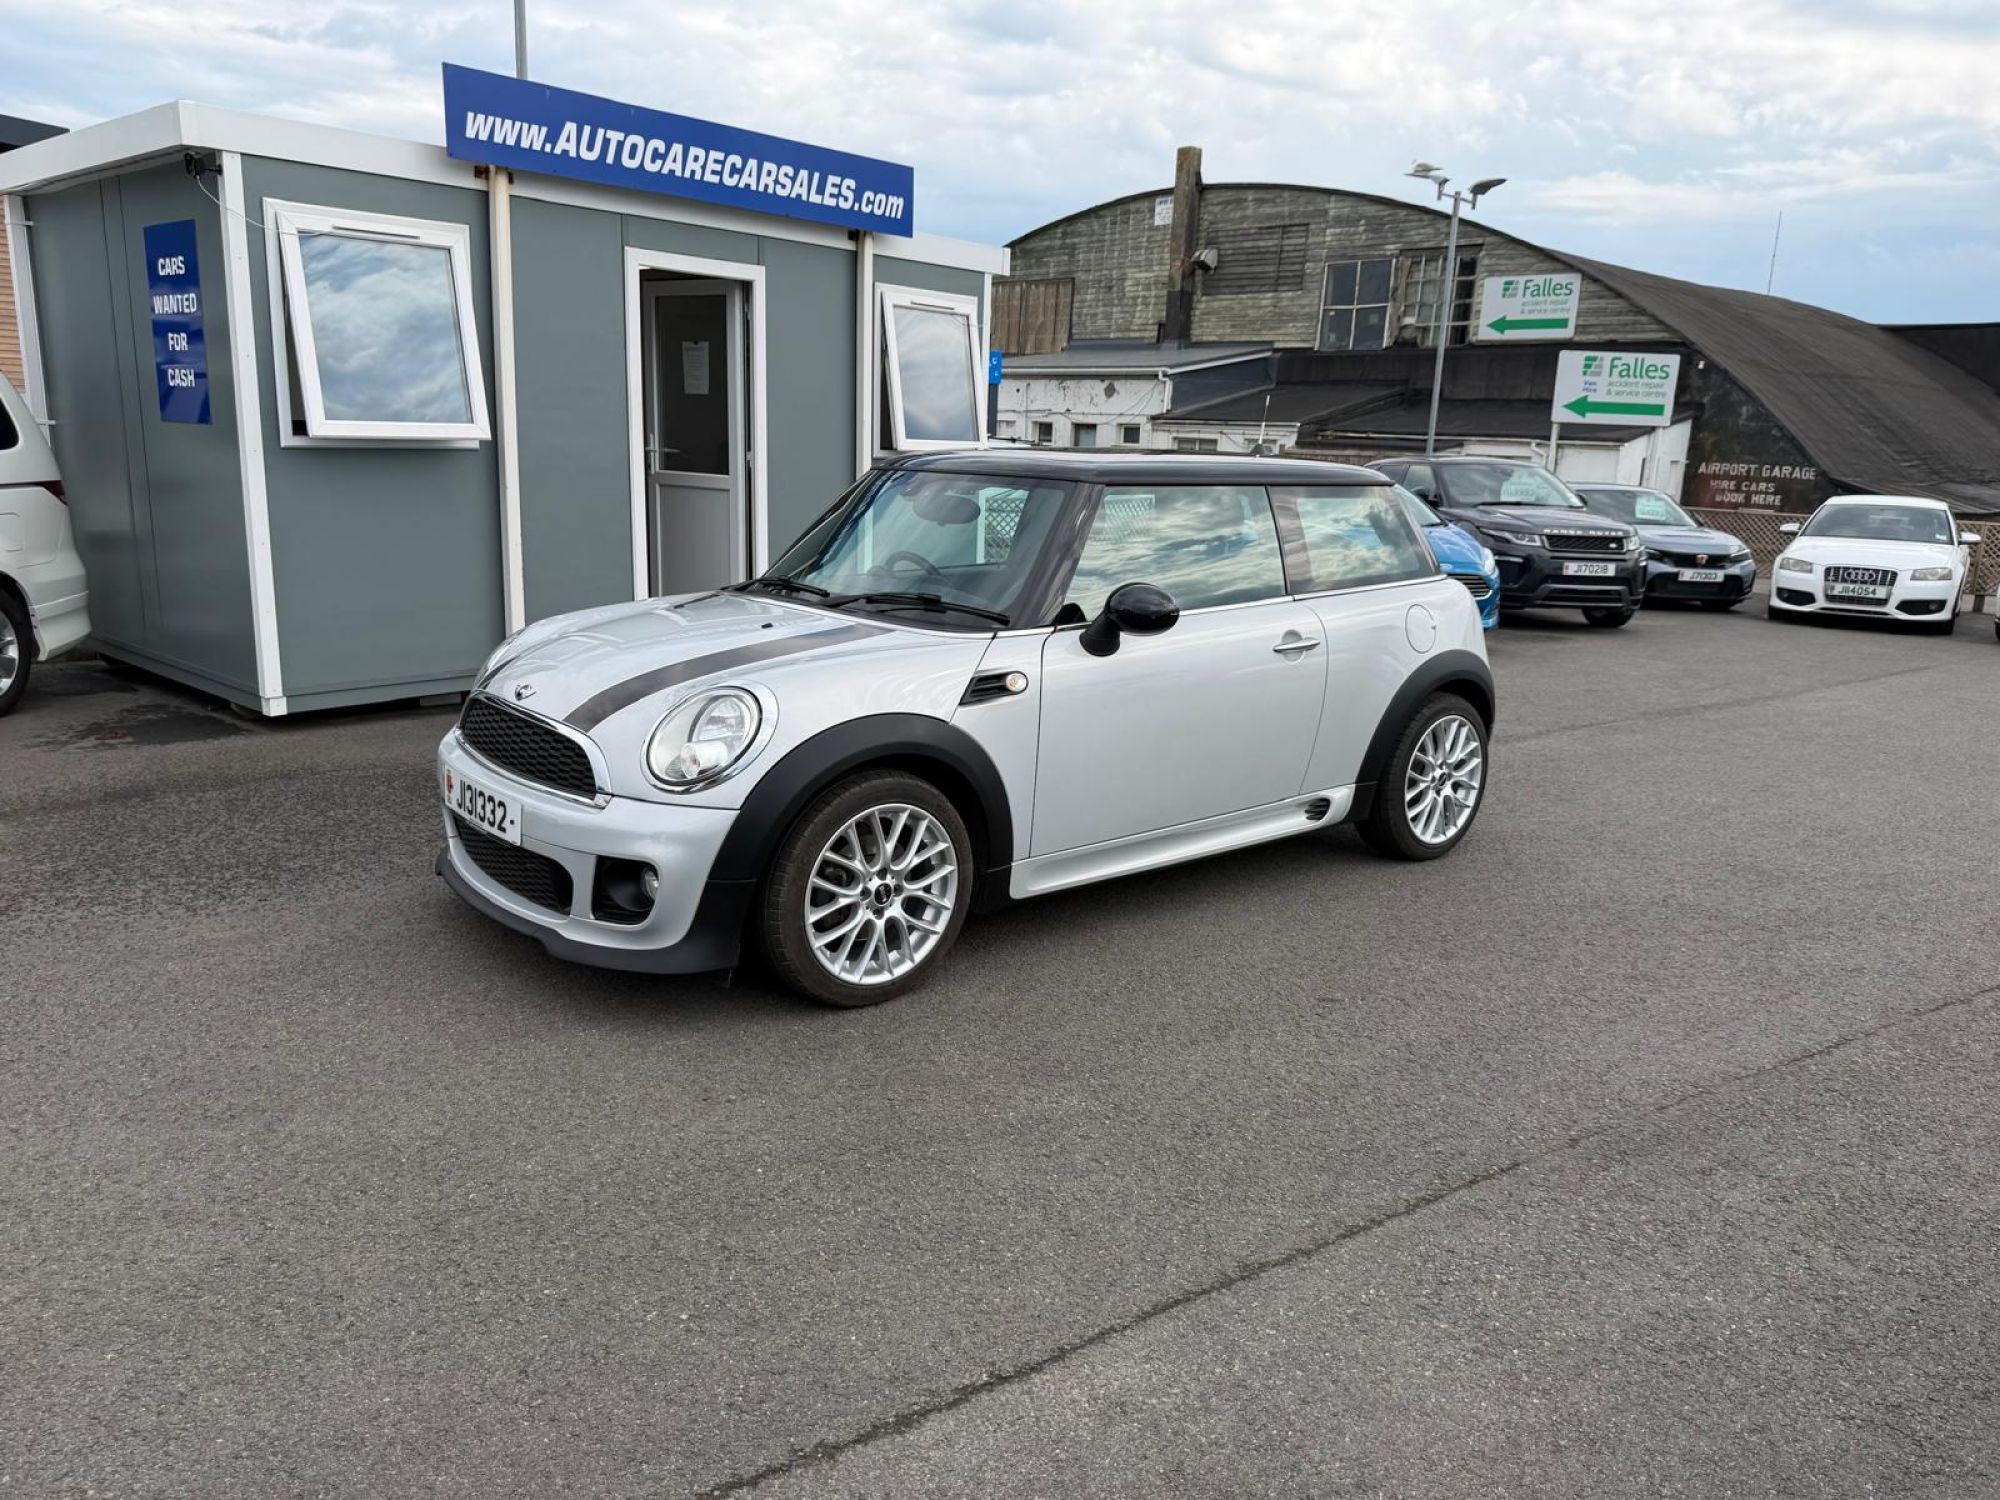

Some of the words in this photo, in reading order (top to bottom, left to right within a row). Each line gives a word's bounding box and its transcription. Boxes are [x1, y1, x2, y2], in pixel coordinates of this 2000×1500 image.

[465, 111, 904, 219] www.AUTOCARECARSALES.com
[158, 256, 185, 275] CARS
[1522, 278, 1574, 297] Falles
[153, 293, 197, 314] WANTED
[168, 333, 188, 351] FOR
[168, 368, 195, 387] CASH
[1608, 357, 1670, 379] Falles
[1614, 389, 1640, 397] service
[1698, 462, 1758, 476] AIRPORT
[1761, 464, 1816, 480] GARAGE
[1741, 482, 1775, 492] CARS
[1751, 494, 1781, 505] HERE
[456, 779, 507, 834] J131332
